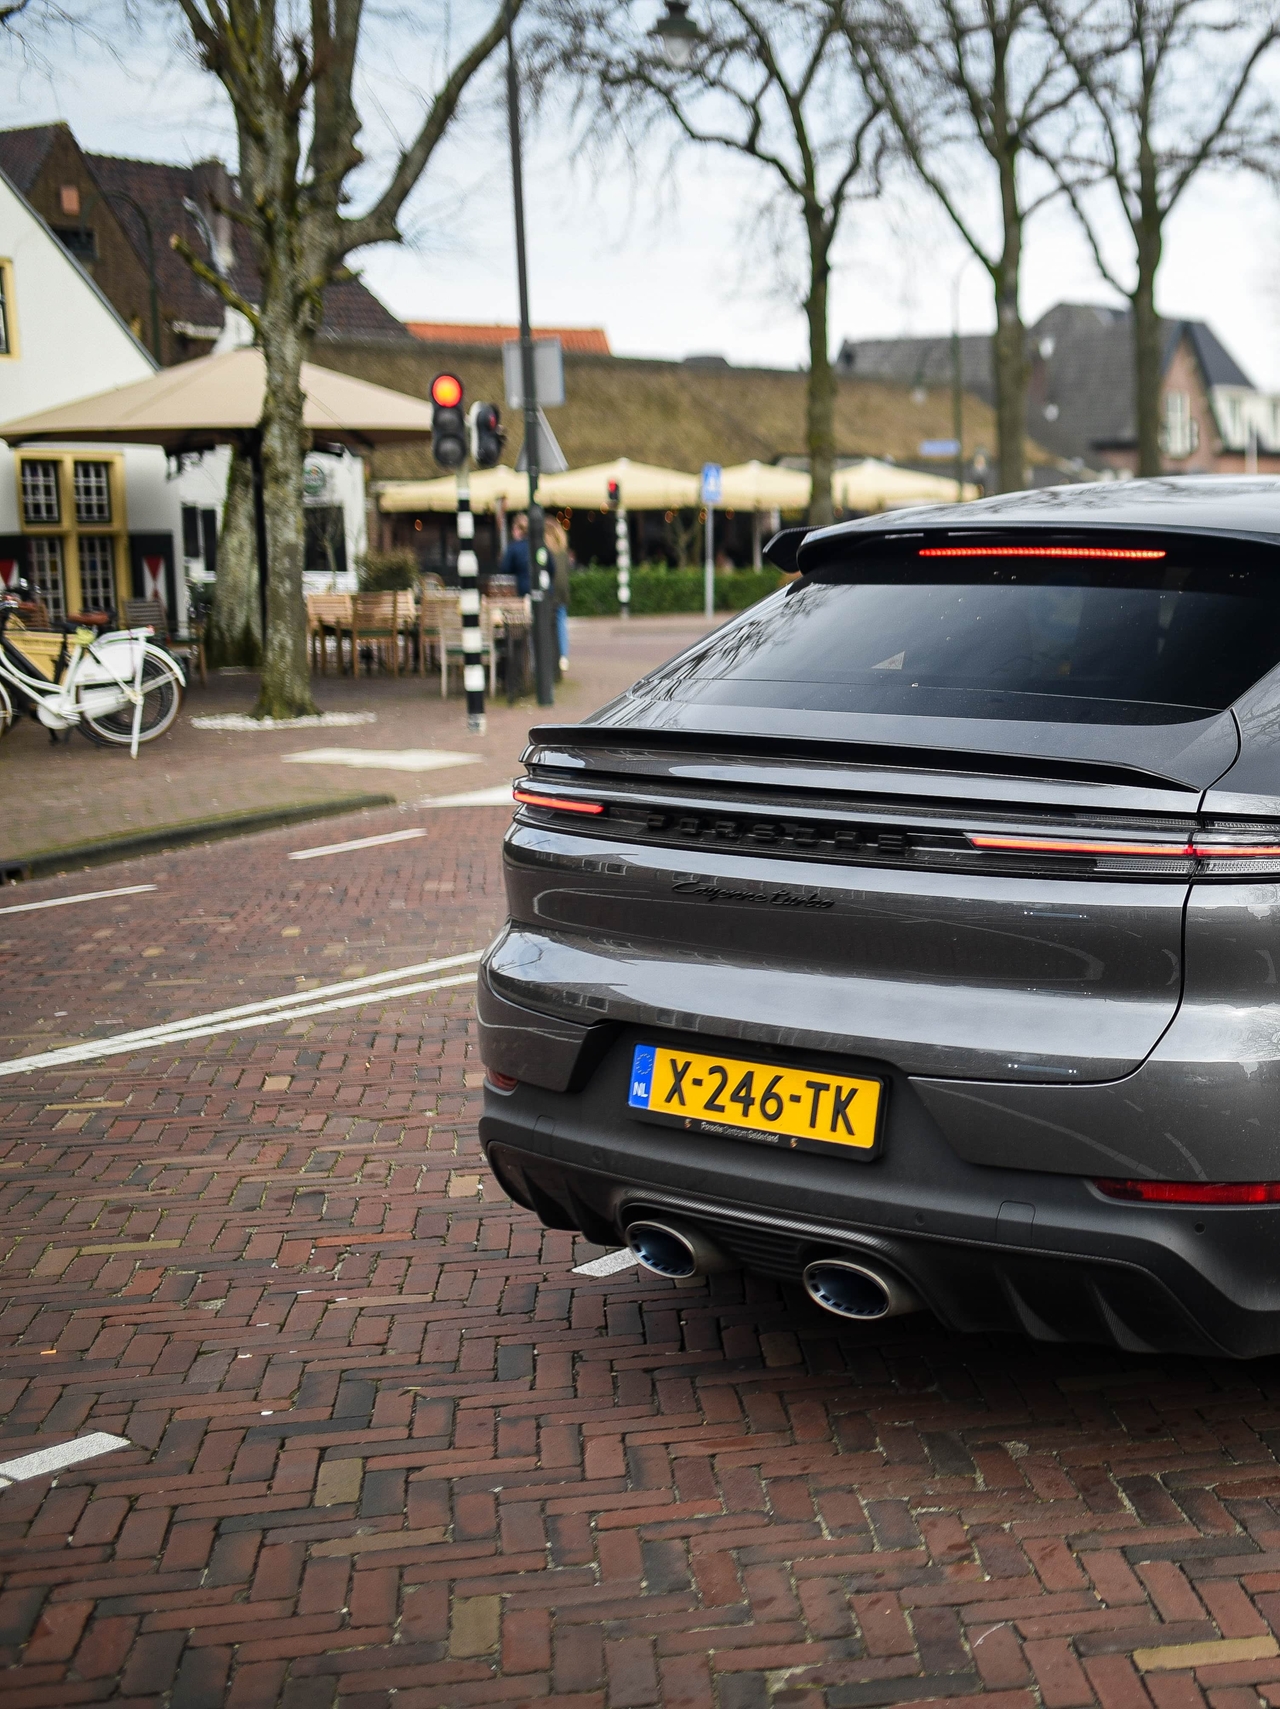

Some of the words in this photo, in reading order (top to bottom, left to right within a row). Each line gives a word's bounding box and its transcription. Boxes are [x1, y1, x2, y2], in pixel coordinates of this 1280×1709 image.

[646, 814, 911, 850] PORSCHE
[672, 881, 767, 902] Cayenne
[770, 889, 836, 908] turbo
[632, 1081, 648, 1098] NL
[664, 1058, 859, 1136] X-246-TK
